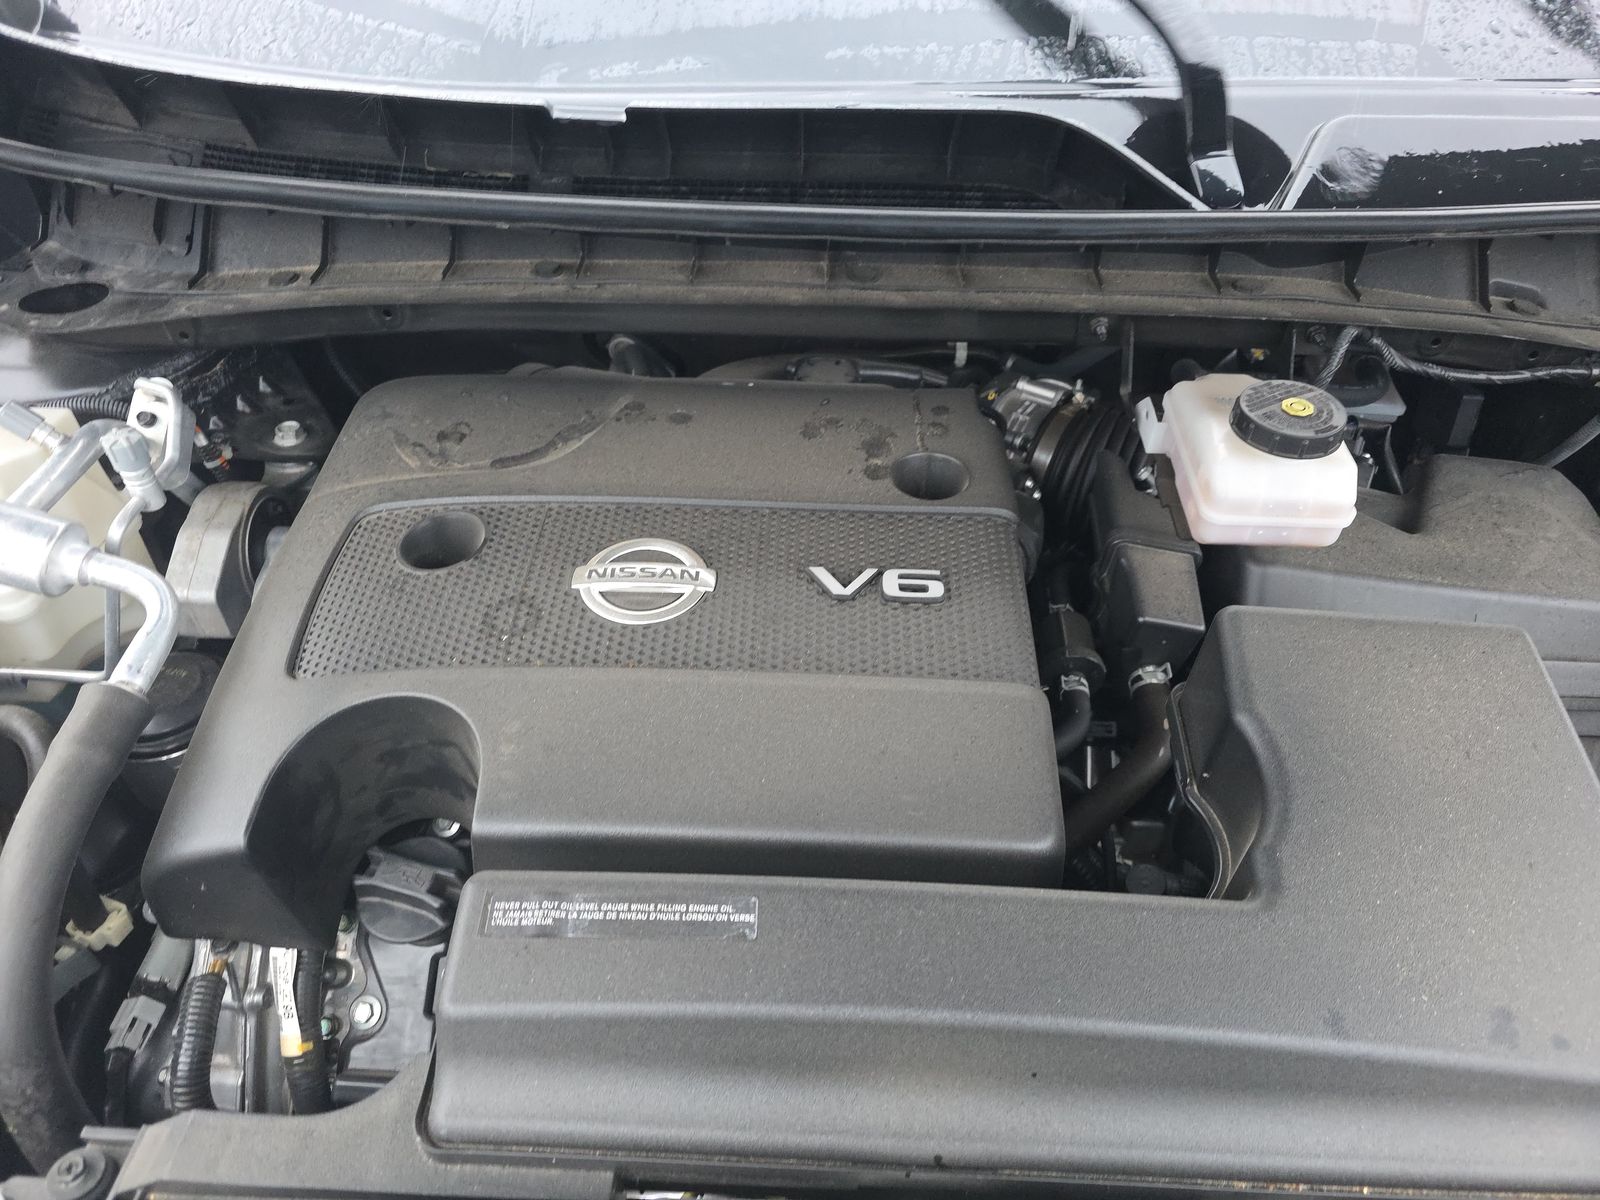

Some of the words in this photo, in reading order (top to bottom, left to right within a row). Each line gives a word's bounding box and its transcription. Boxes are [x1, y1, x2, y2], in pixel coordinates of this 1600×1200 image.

[586, 566, 700, 582] NISSAN
[808, 566, 945, 602] V6
[494, 901, 520, 910] NEVER
[521, 901, 539, 909] PULL
[541, 900, 558, 909] OUT
[560, 901, 573, 910] OIL
[575, 902, 599, 911] LEVEL
[600, 902, 629, 911] GAUGE
[630, 903, 655, 912] WHILE
[656, 903, 687, 912] FILLING
[688, 904, 719, 913] ENGINE
[492, 910, 503, 918] NE
[567, 911, 578, 919] LA
[579, 911, 604, 920] JAUGE
[606, 911, 617, 920] DE
[618, 911, 648, 921] NIVEAU
[649, 912, 680, 921] D'HUILE
[729, 913, 756, 923] VERSE
